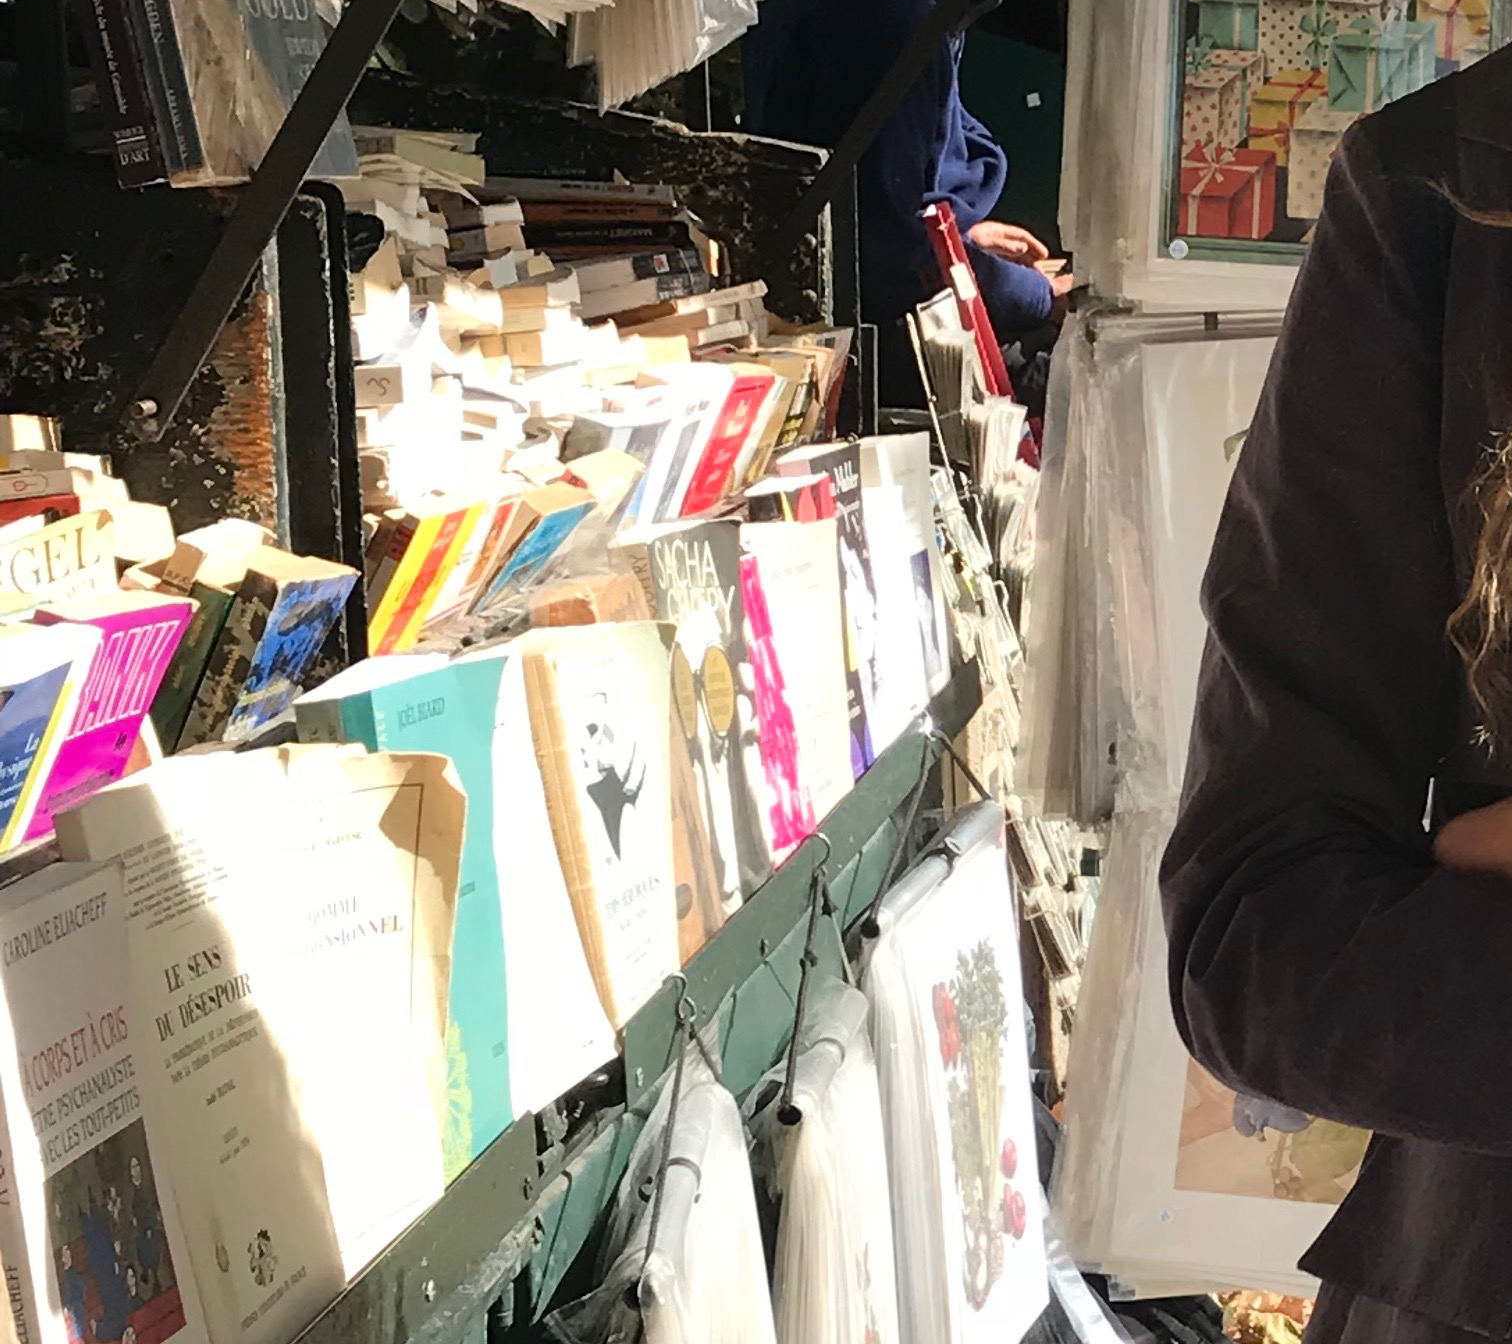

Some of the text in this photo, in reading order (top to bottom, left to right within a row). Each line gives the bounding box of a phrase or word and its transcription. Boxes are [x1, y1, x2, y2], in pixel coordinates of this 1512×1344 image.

[0, 526, 101, 594] GEL
[654, 539, 720, 590] SACHA
[397, 702, 417, 733] JOËL
[3, 892, 107, 967] CAROLINE ELIACHEFF
[164, 945, 222, 994] LE SENS
[155, 973, 252, 1043] DU DÉSESPOIR
[31, 1038, 73, 1092] CORPS
[71, 1026, 89, 1067] ET
[86, 1011, 102, 1058] À
[100, 1005, 129, 1051] CRIS
[56, 1054, 136, 1123] PSYCHANALYSTE
[41, 1085, 141, 1166] VEC LES TOUT-PETITS
